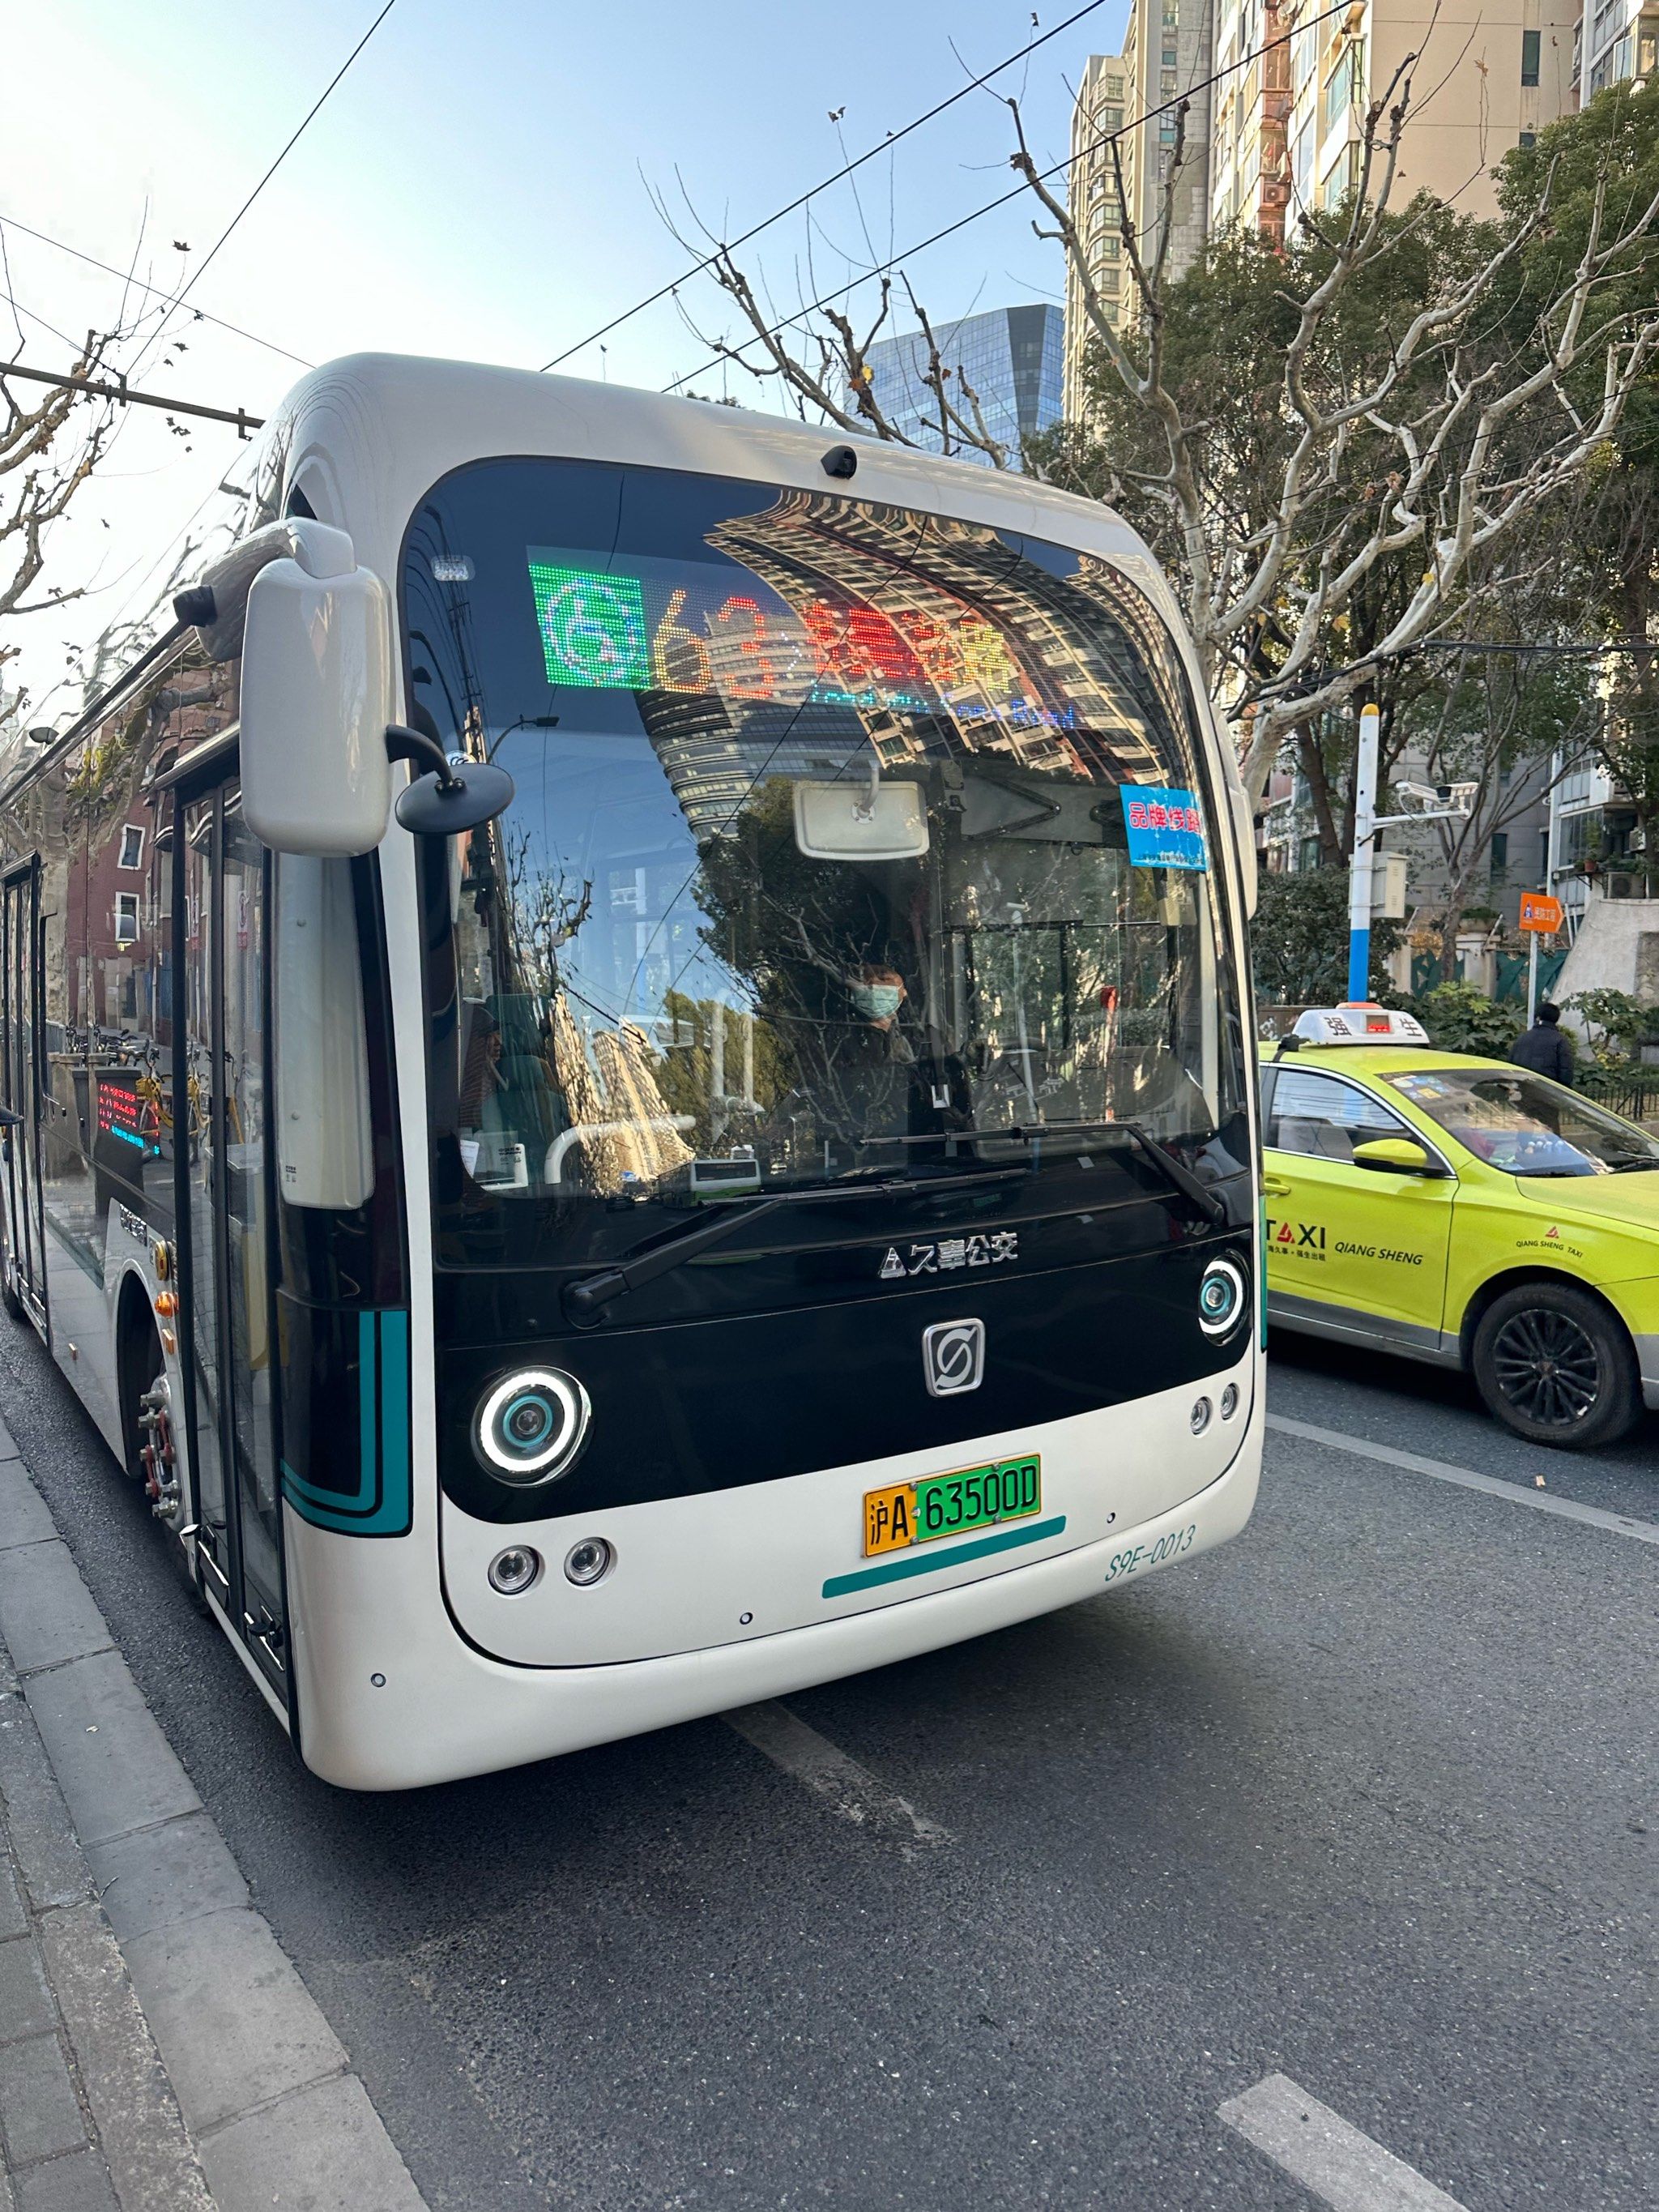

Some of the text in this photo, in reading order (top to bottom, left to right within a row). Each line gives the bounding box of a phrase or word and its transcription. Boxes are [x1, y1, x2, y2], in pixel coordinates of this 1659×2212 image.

[652, 588, 775, 700] 63
[1324, 1017, 1352, 1036] 强
[1399, 1018, 1422, 1037] 生
[1266, 1219, 1325, 1249] TAXI
[1516, 1240, 1584, 1258] QIANG SHENG TAXI
[1335, 1241, 1423, 1265] QIANG SHENG
[925, 1464, 1037, 1531] 63500D
[870, 1494, 909, 1545] 沪A
[1105, 1524, 1196, 1582] S9E-0013
